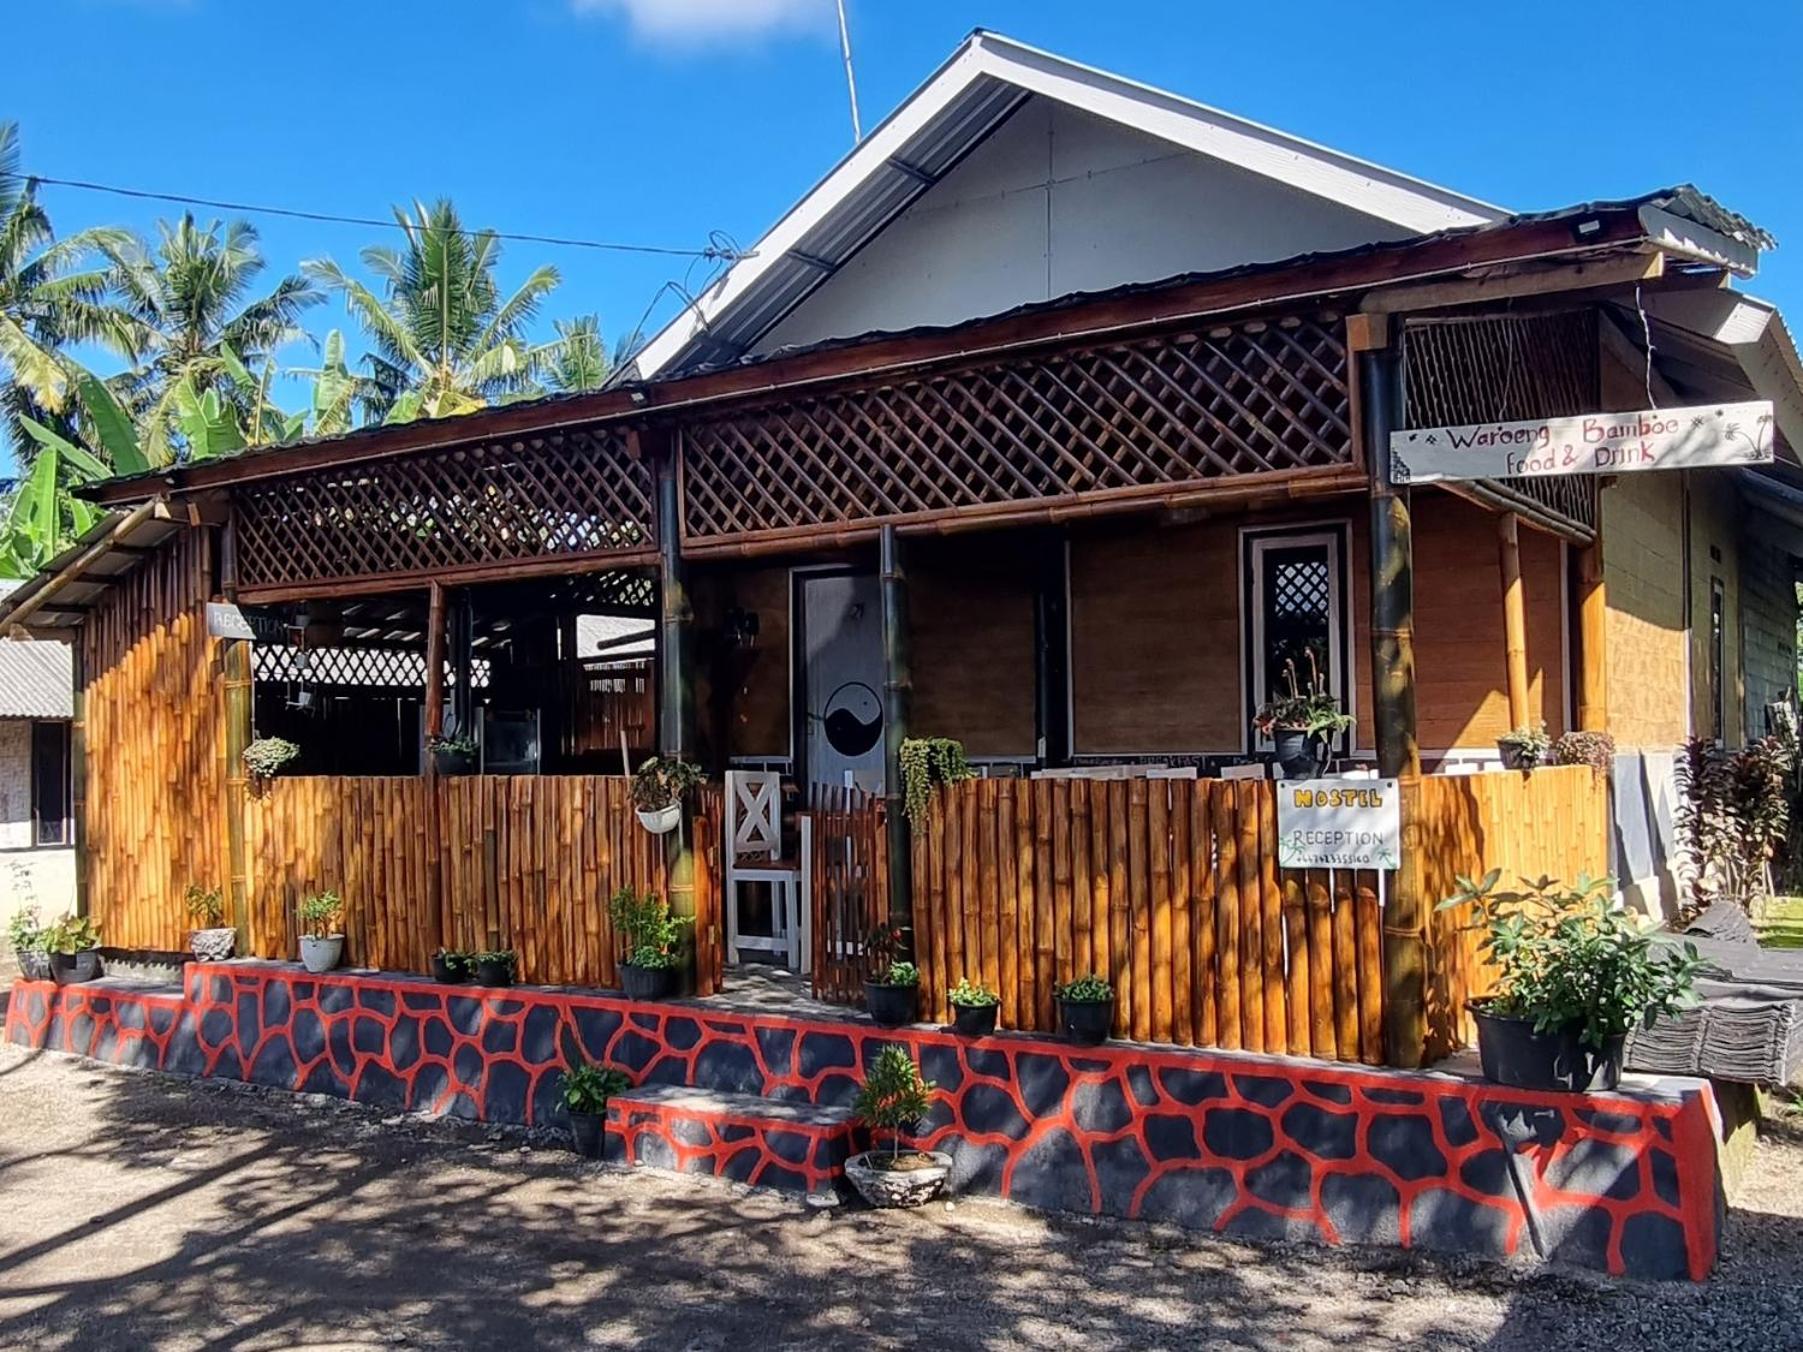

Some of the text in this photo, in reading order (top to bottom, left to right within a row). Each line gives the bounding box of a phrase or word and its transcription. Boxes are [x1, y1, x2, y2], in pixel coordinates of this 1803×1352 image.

[1562, 443, 1578, 467] &
[1293, 788, 1383, 809] HOSTEL
[1293, 830, 1383, 846] RECEPTION
